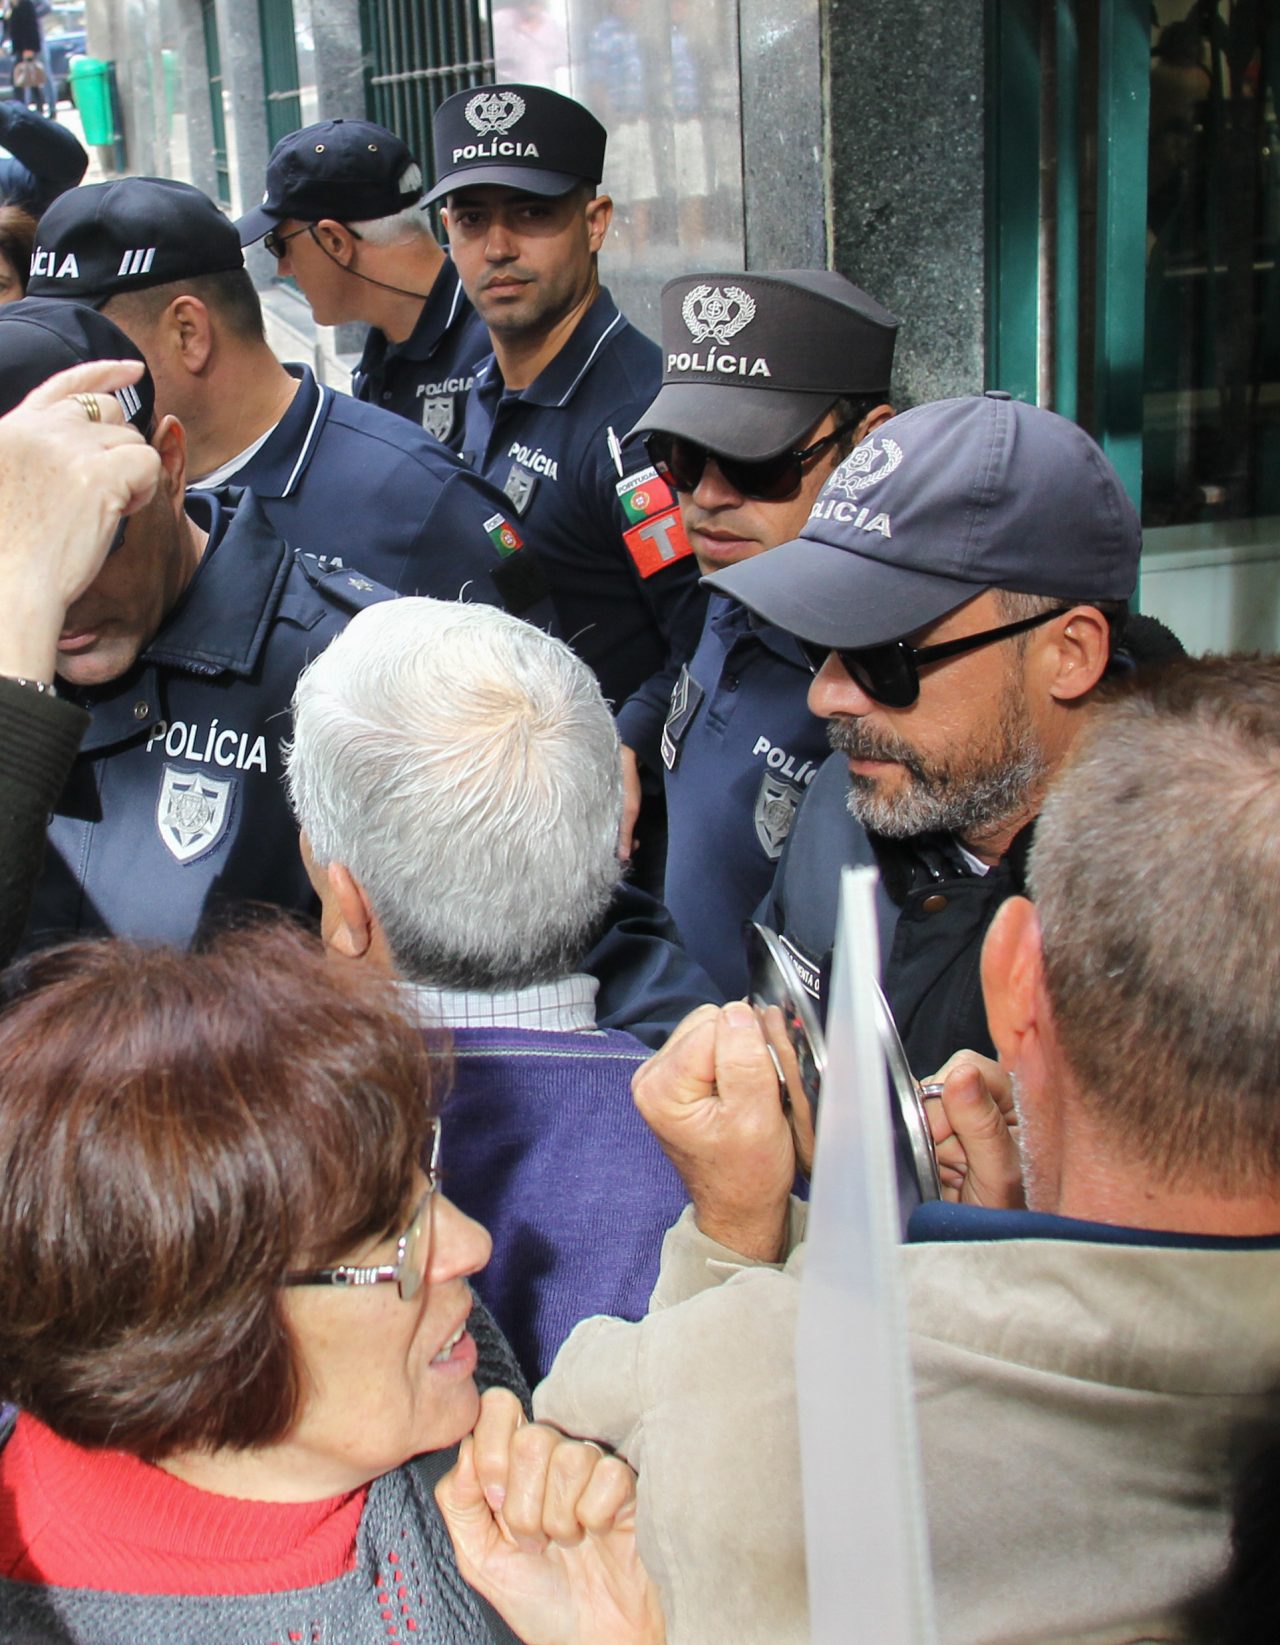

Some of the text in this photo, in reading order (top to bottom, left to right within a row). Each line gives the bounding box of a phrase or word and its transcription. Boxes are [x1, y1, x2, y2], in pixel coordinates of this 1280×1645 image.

[452, 136, 540, 165] POLÍCIA
[29, 245, 80, 279] LÍCIA
[666, 345, 772, 378] POLÍCIA
[415, 376, 475, 399] POLÍCIA
[507, 441, 559, 482] POLÍCIA
[639, 513, 678, 562] T
[146, 717, 268, 773] POLÍCIA
